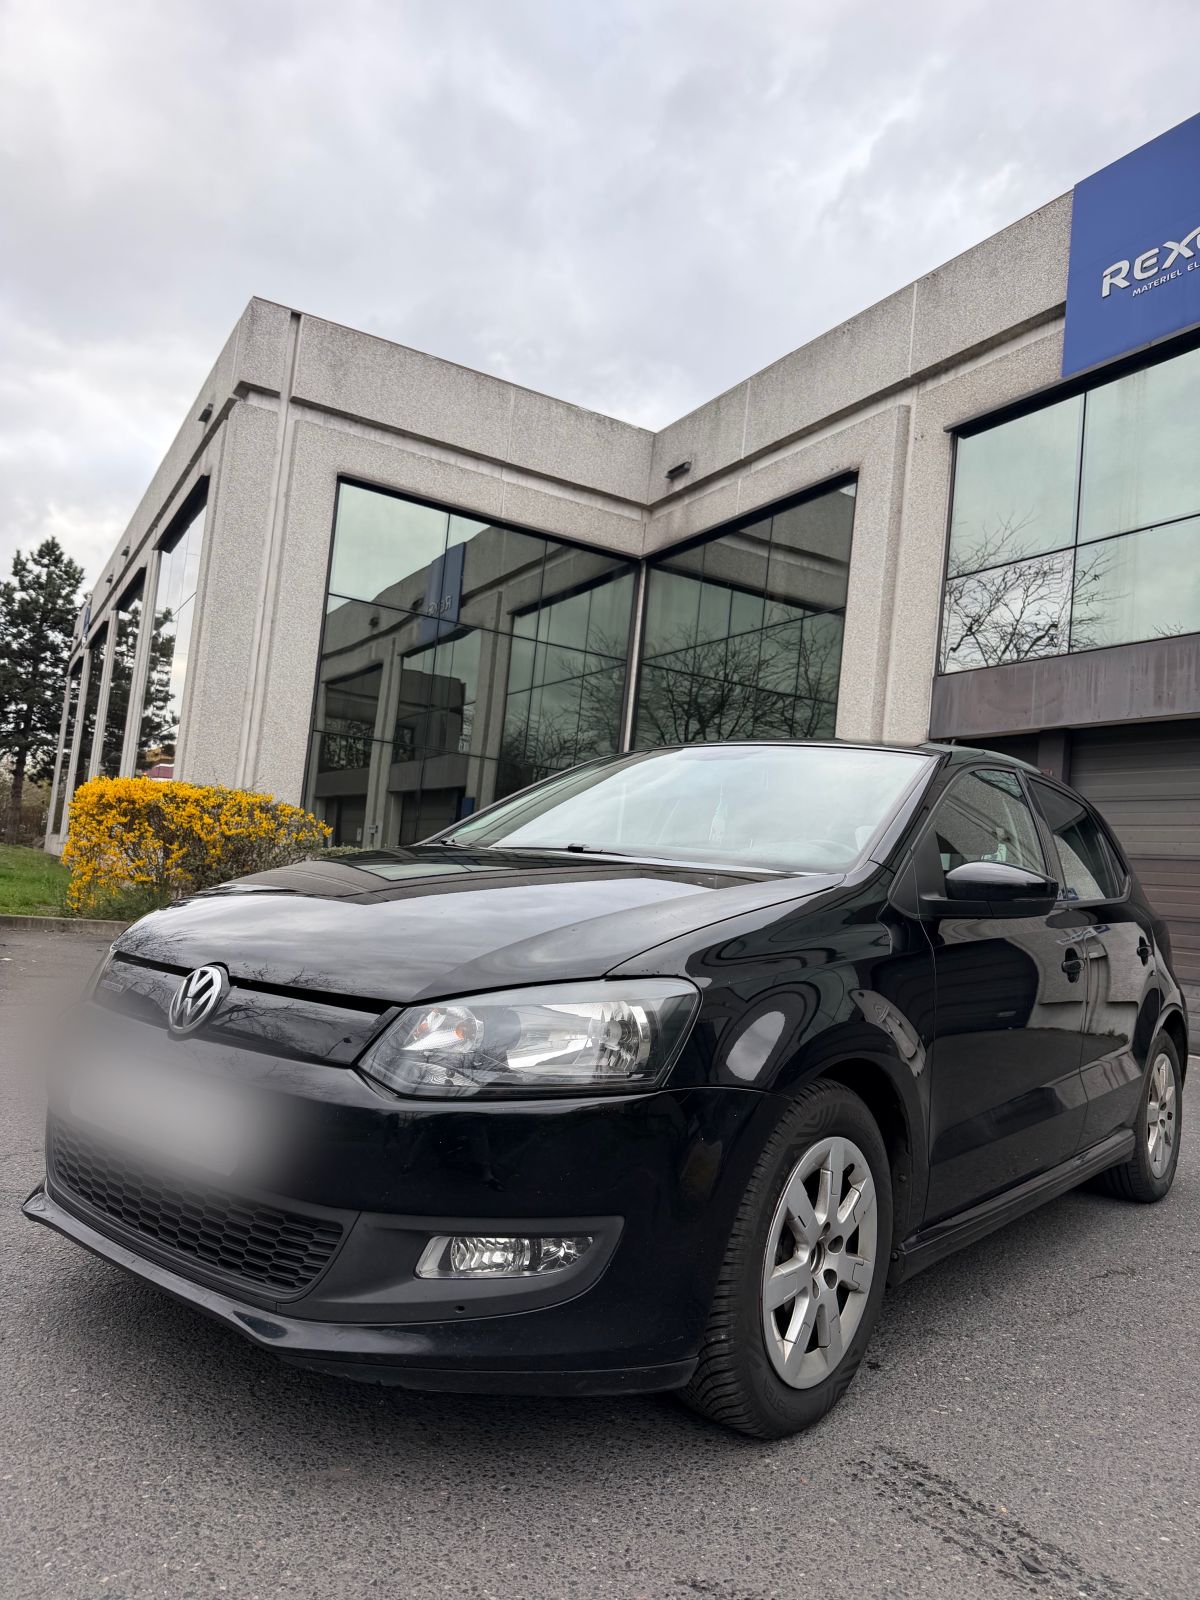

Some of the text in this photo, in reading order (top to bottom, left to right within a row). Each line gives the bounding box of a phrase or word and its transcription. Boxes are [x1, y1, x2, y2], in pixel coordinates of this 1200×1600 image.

[1101, 226, 1200, 298] REX
[1132, 269, 1183, 297] MATERIEL
[171, 967, 220, 1032] VW
